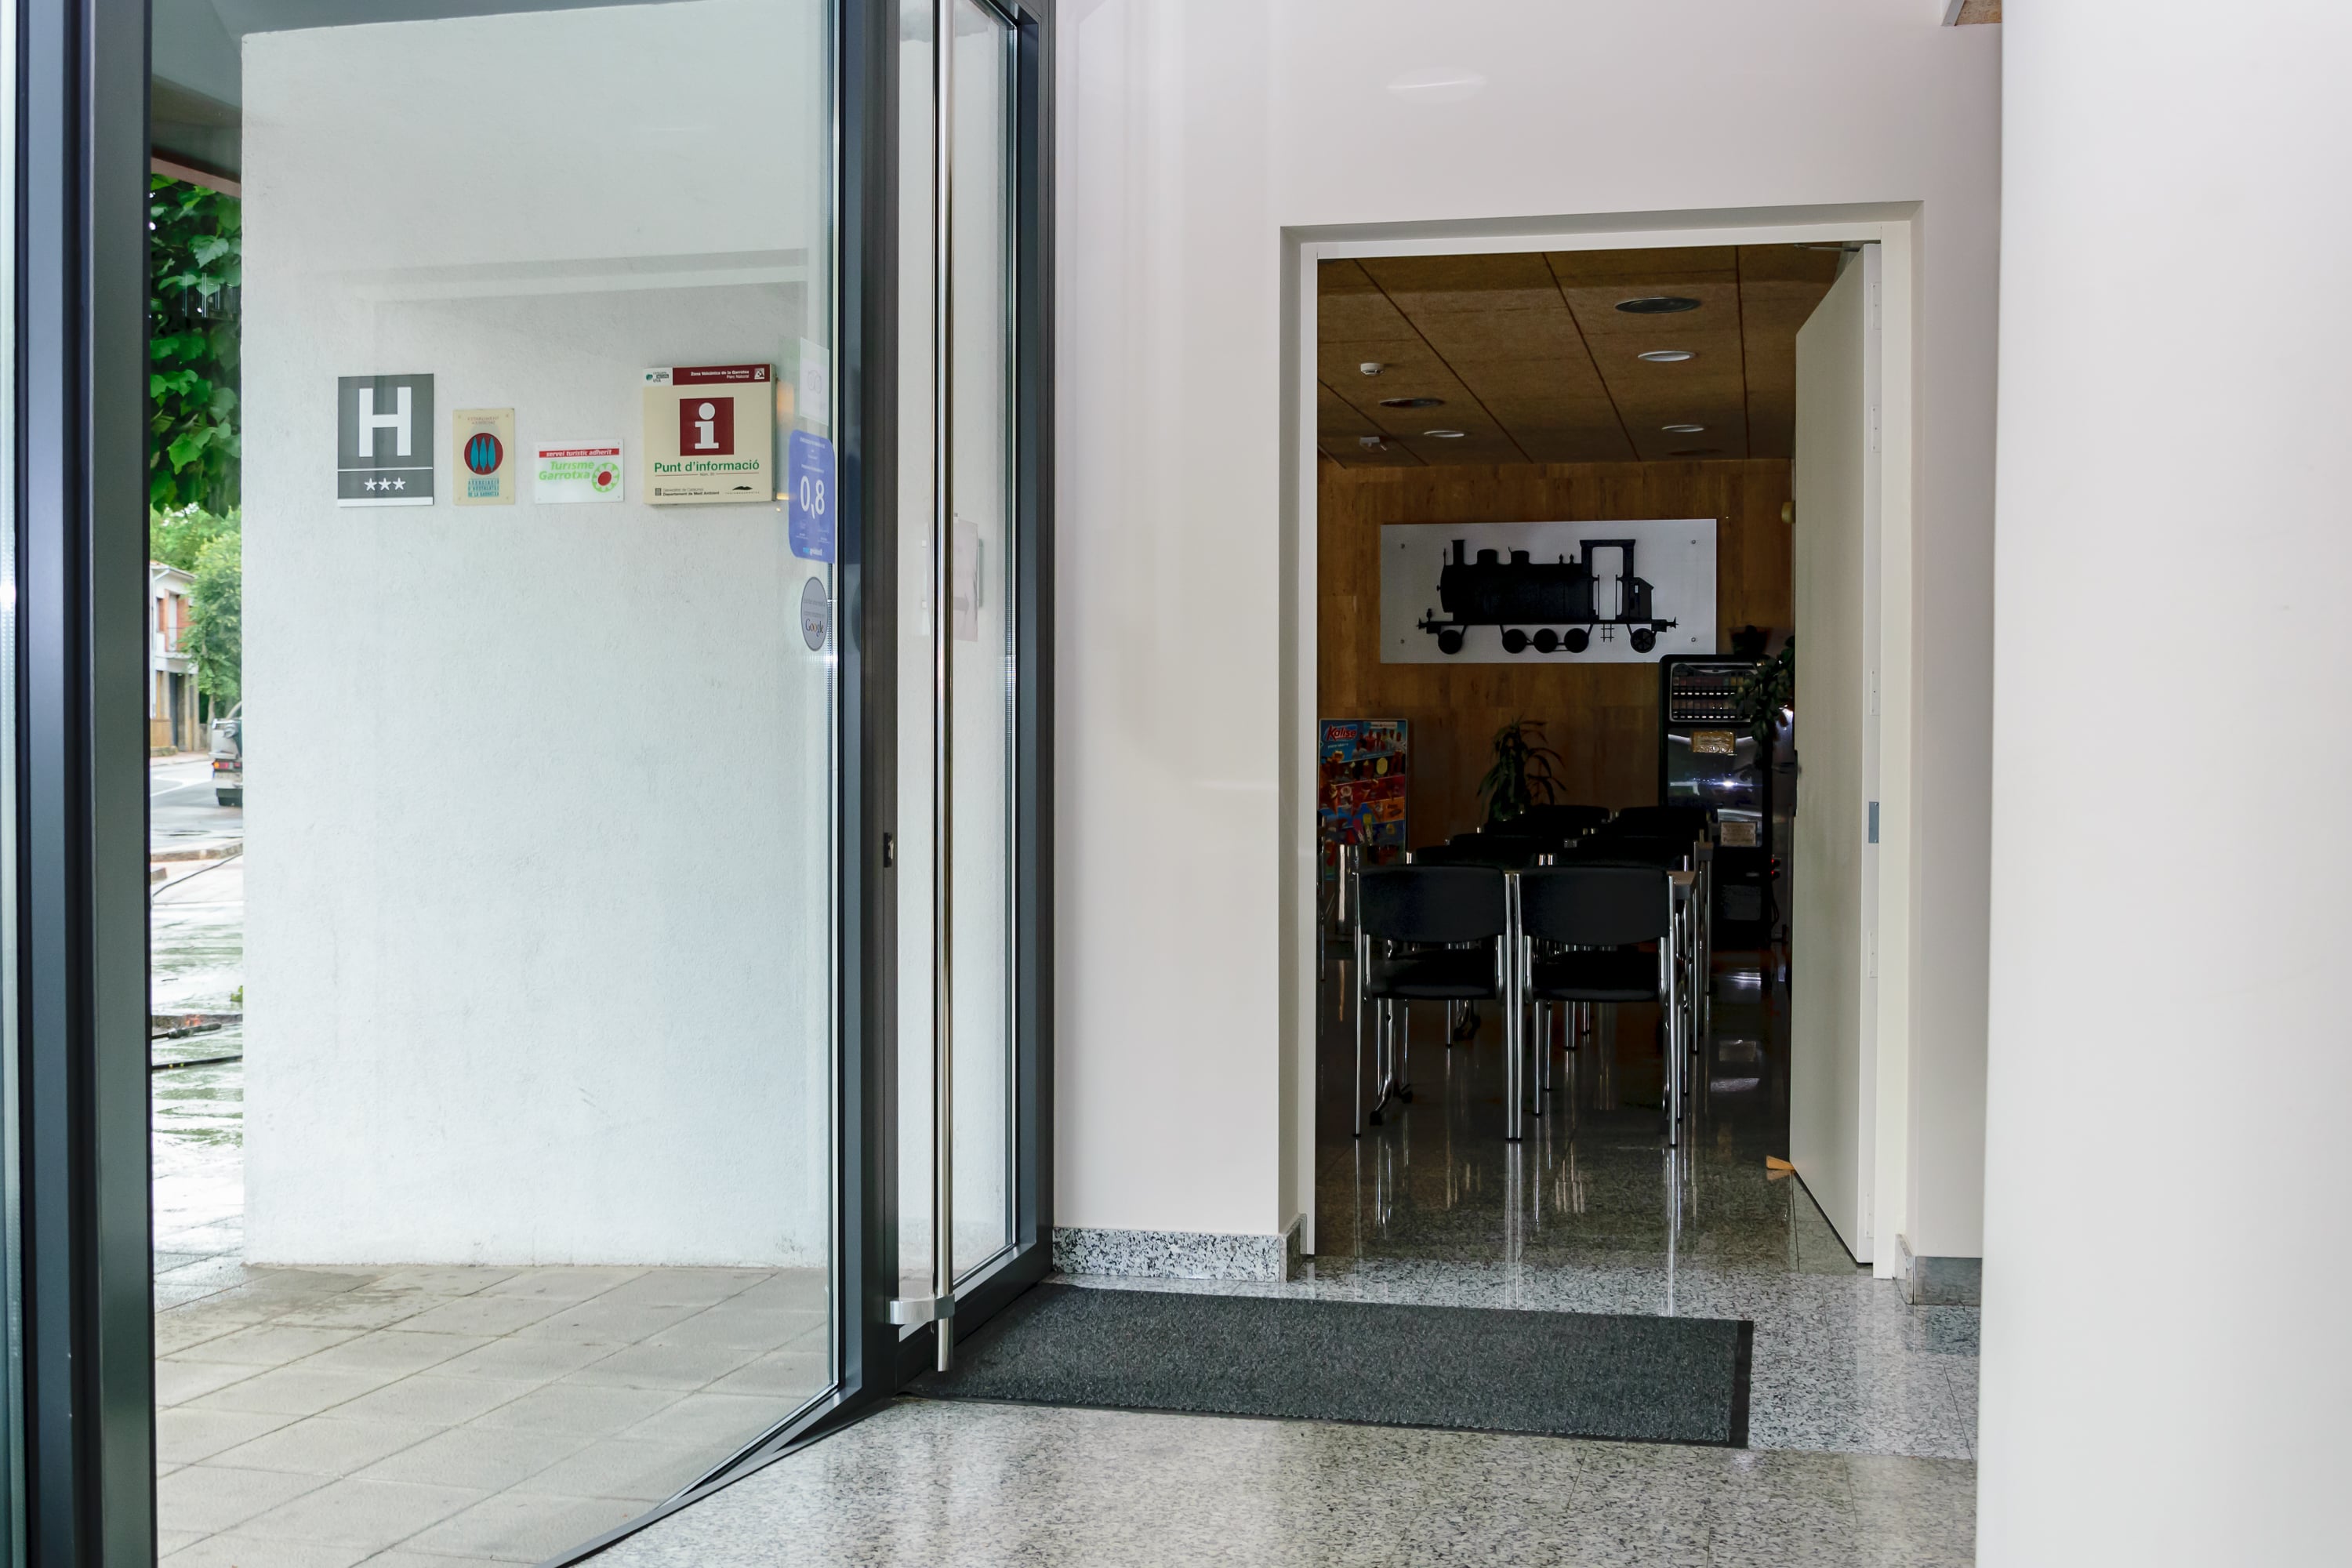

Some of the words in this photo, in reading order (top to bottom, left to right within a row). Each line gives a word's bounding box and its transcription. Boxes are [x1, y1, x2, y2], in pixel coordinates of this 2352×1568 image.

[358, 387, 412, 458] H
[550, 461, 595, 471] Turisme
[654, 462, 682, 473] Punt
[685, 460, 760, 472] d'informació
[539, 470, 591, 481] Garrotxa
[806, 619, 823, 637] Google
[1327, 724, 1357, 741] Kalise
